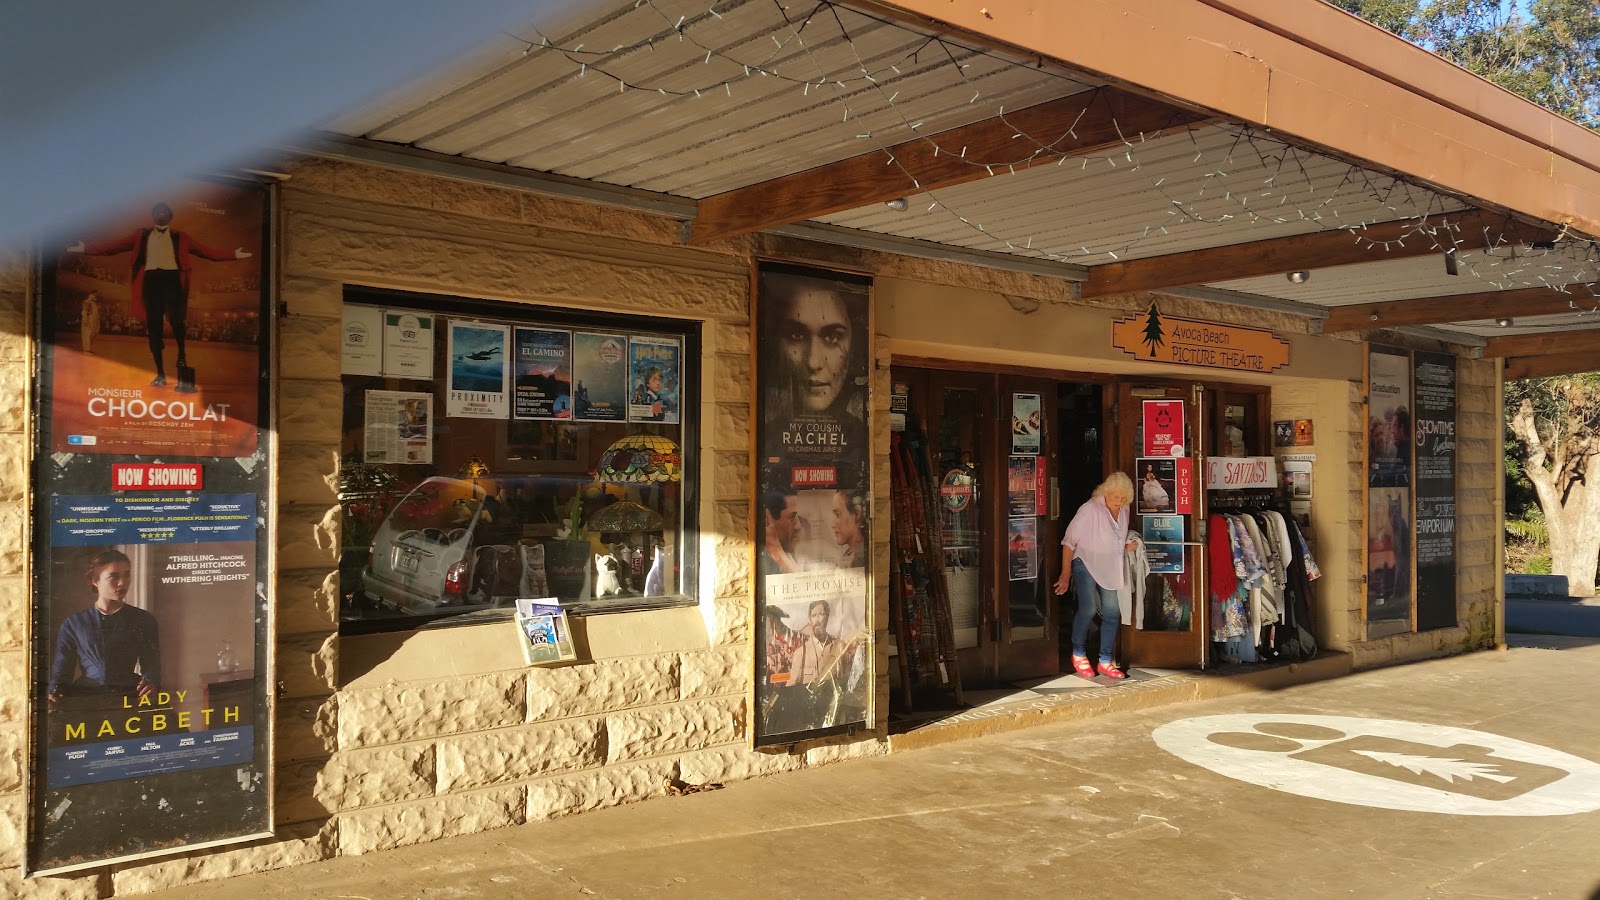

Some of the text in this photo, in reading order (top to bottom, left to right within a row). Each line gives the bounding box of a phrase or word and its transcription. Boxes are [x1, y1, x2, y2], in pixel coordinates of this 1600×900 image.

[1172, 325, 1229, 344] Avoca Beach
[533, 348, 564, 357] CAMINO
[1172, 346, 1263, 369] PICTURE THEATRE
[88, 388, 142, 398] MONSIEUR
[1372, 382, 1401, 394] Graduation
[452, 392, 503, 403] PROXIMITY
[88, 398, 230, 422] CHOCOLAT
[806, 424, 841, 432] COUSIN
[1416, 419, 1455, 446] SHOWTIME
[782, 432, 847, 445] RACHEL
[118, 468, 196, 486] NOW SHOWING
[795, 470, 834, 482] NOW SHOWING
[1154, 518, 1171, 528] BLUE
[1417, 519, 1454, 534] EMPORIUM
[771, 577, 862, 594] THE PROMISE
[123, 690, 187, 708] LADY
[65, 706, 239, 740] MACBETH
